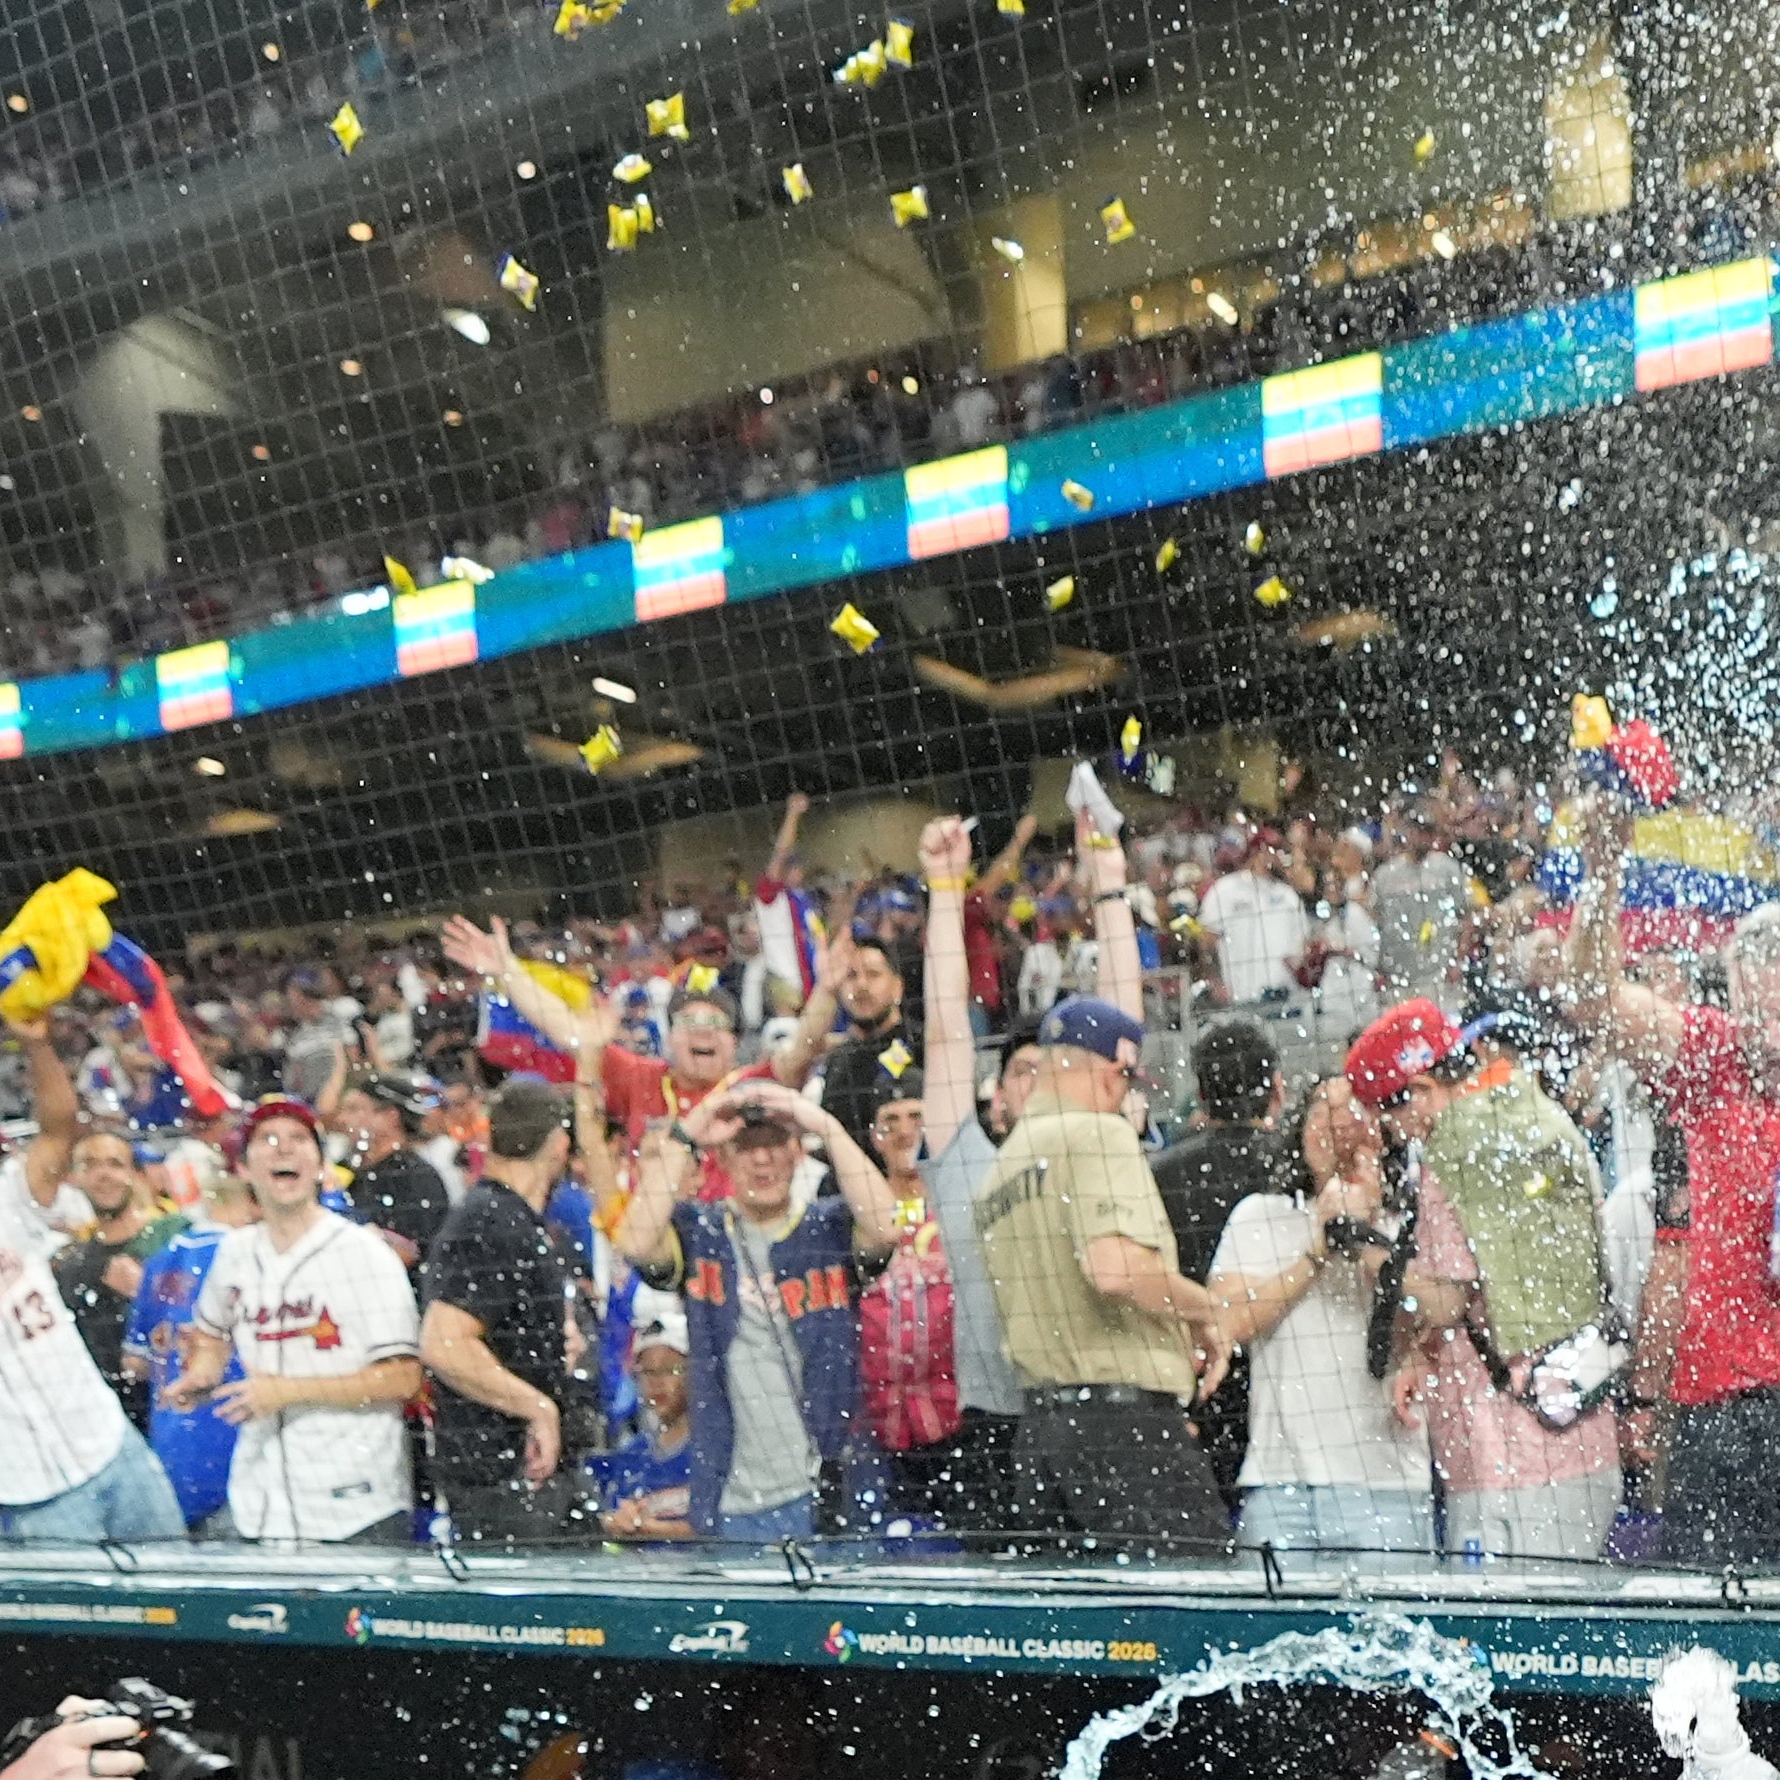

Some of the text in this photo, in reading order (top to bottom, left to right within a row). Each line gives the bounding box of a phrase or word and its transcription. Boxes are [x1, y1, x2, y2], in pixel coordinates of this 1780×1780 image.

[858, 1633, 1157, 1661] WORLD BASEBALL CLASSIC 2026
[1491, 1652, 1579, 1677] WORLD
